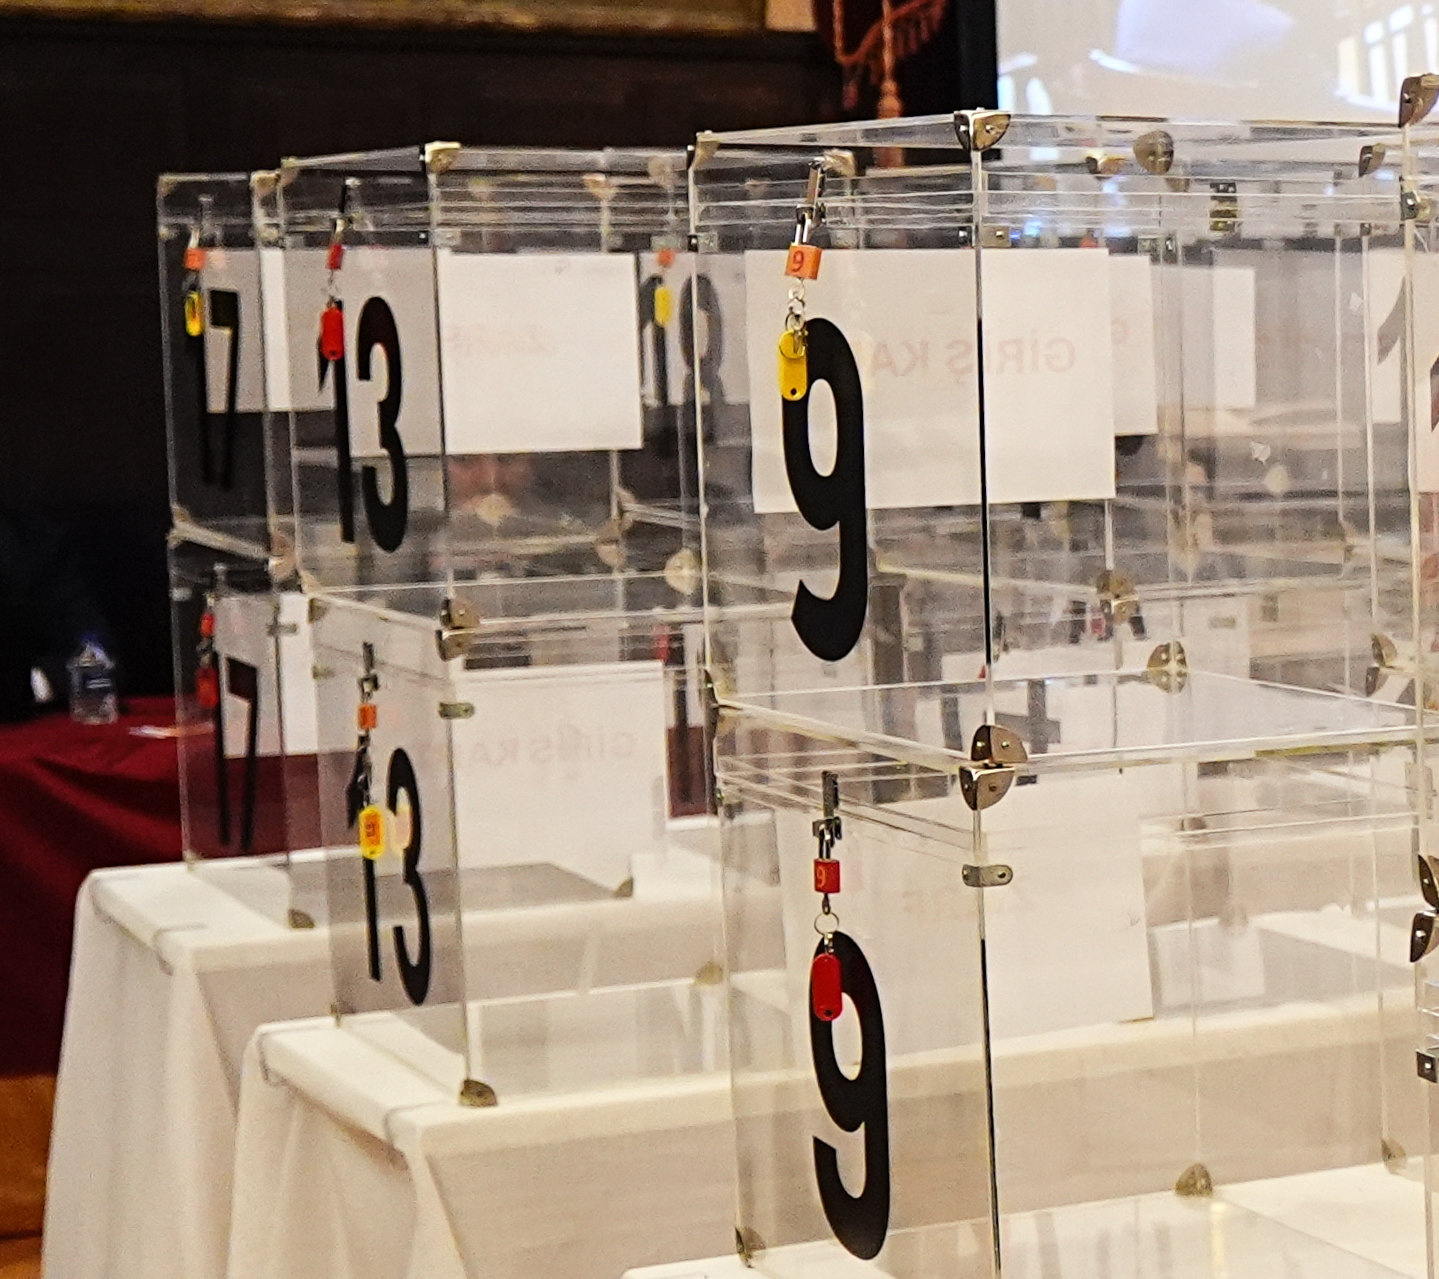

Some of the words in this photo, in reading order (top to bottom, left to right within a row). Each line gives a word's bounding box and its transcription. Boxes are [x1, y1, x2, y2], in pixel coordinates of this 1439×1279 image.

[317, 295, 408, 553] 13
[782, 318, 868, 662] 9
[346, 729, 431, 1006] 13
[809, 929, 892, 1260] 9
